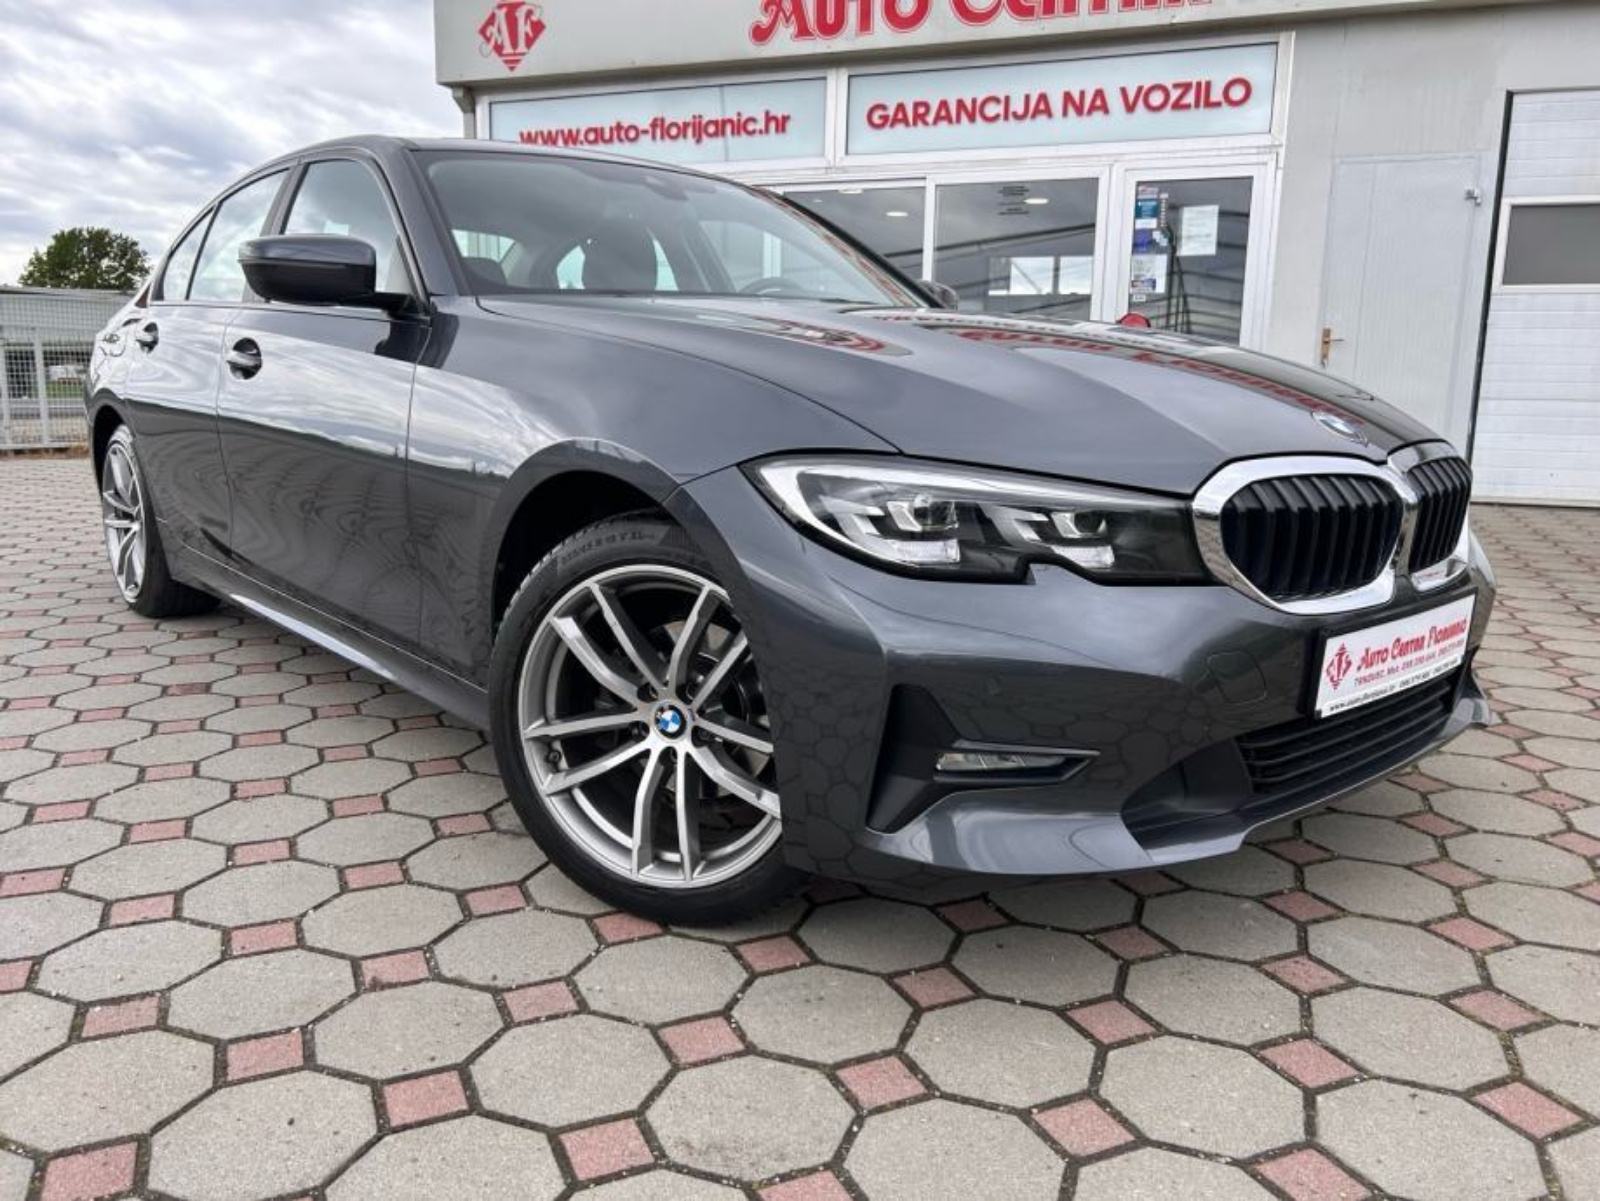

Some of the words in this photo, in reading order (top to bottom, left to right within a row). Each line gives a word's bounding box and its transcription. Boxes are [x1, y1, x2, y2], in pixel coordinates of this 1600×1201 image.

[866, 92, 1053, 130] GARANCIJA
[1062, 87, 1110, 118] NA
[1119, 77, 1253, 114] VOZILO
[519, 110, 791, 146] www.auto-florijanic.hr
